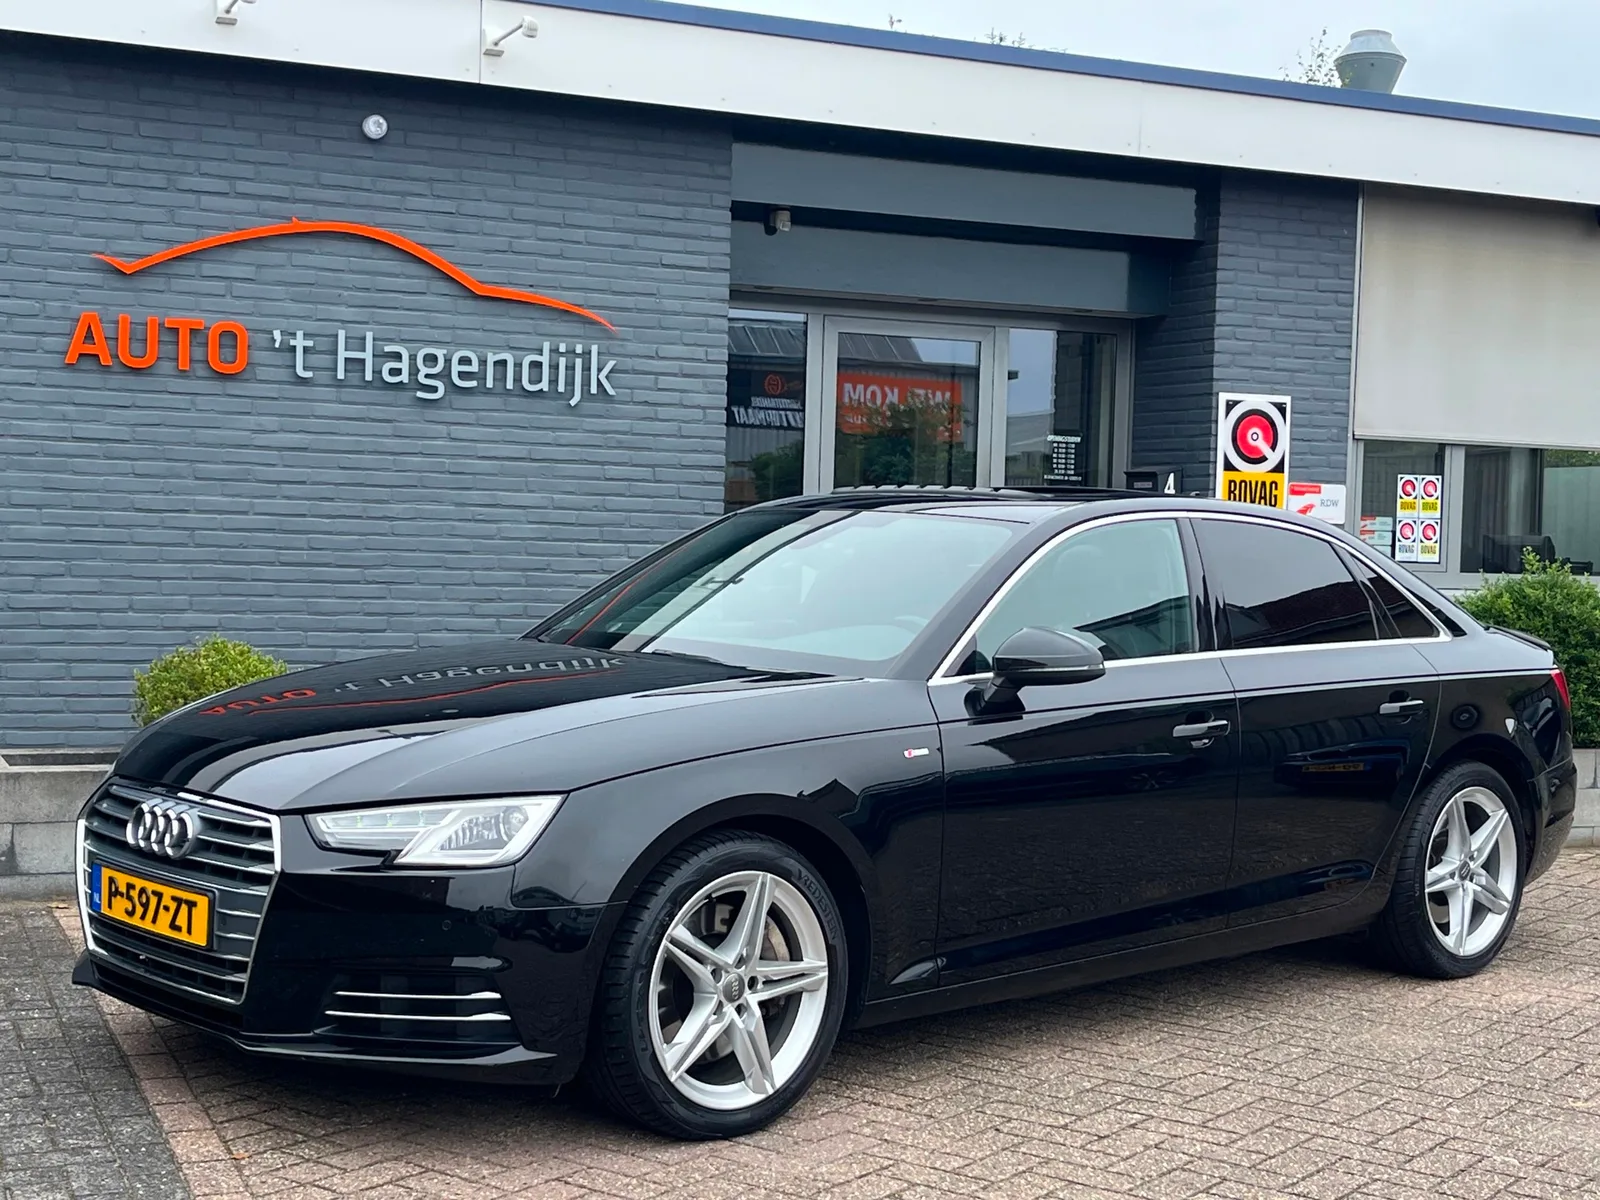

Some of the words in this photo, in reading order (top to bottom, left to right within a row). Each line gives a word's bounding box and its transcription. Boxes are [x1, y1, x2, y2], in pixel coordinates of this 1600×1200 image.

[65, 312, 249, 374] AUTO
[272, 330, 314, 379] 't
[337, 329, 617, 407] Hagendijk
[1164, 472, 1176, 495] 4
[1320, 499, 1340, 507] RDW
[1400, 501, 1417, 511] BOVAG
[1421, 501, 1438, 511] BOVAG
[93, 891, 101, 904] NL
[107, 875, 198, 937] P-597-ZT
[796, 867, 838, 941] VREDESTEIN
